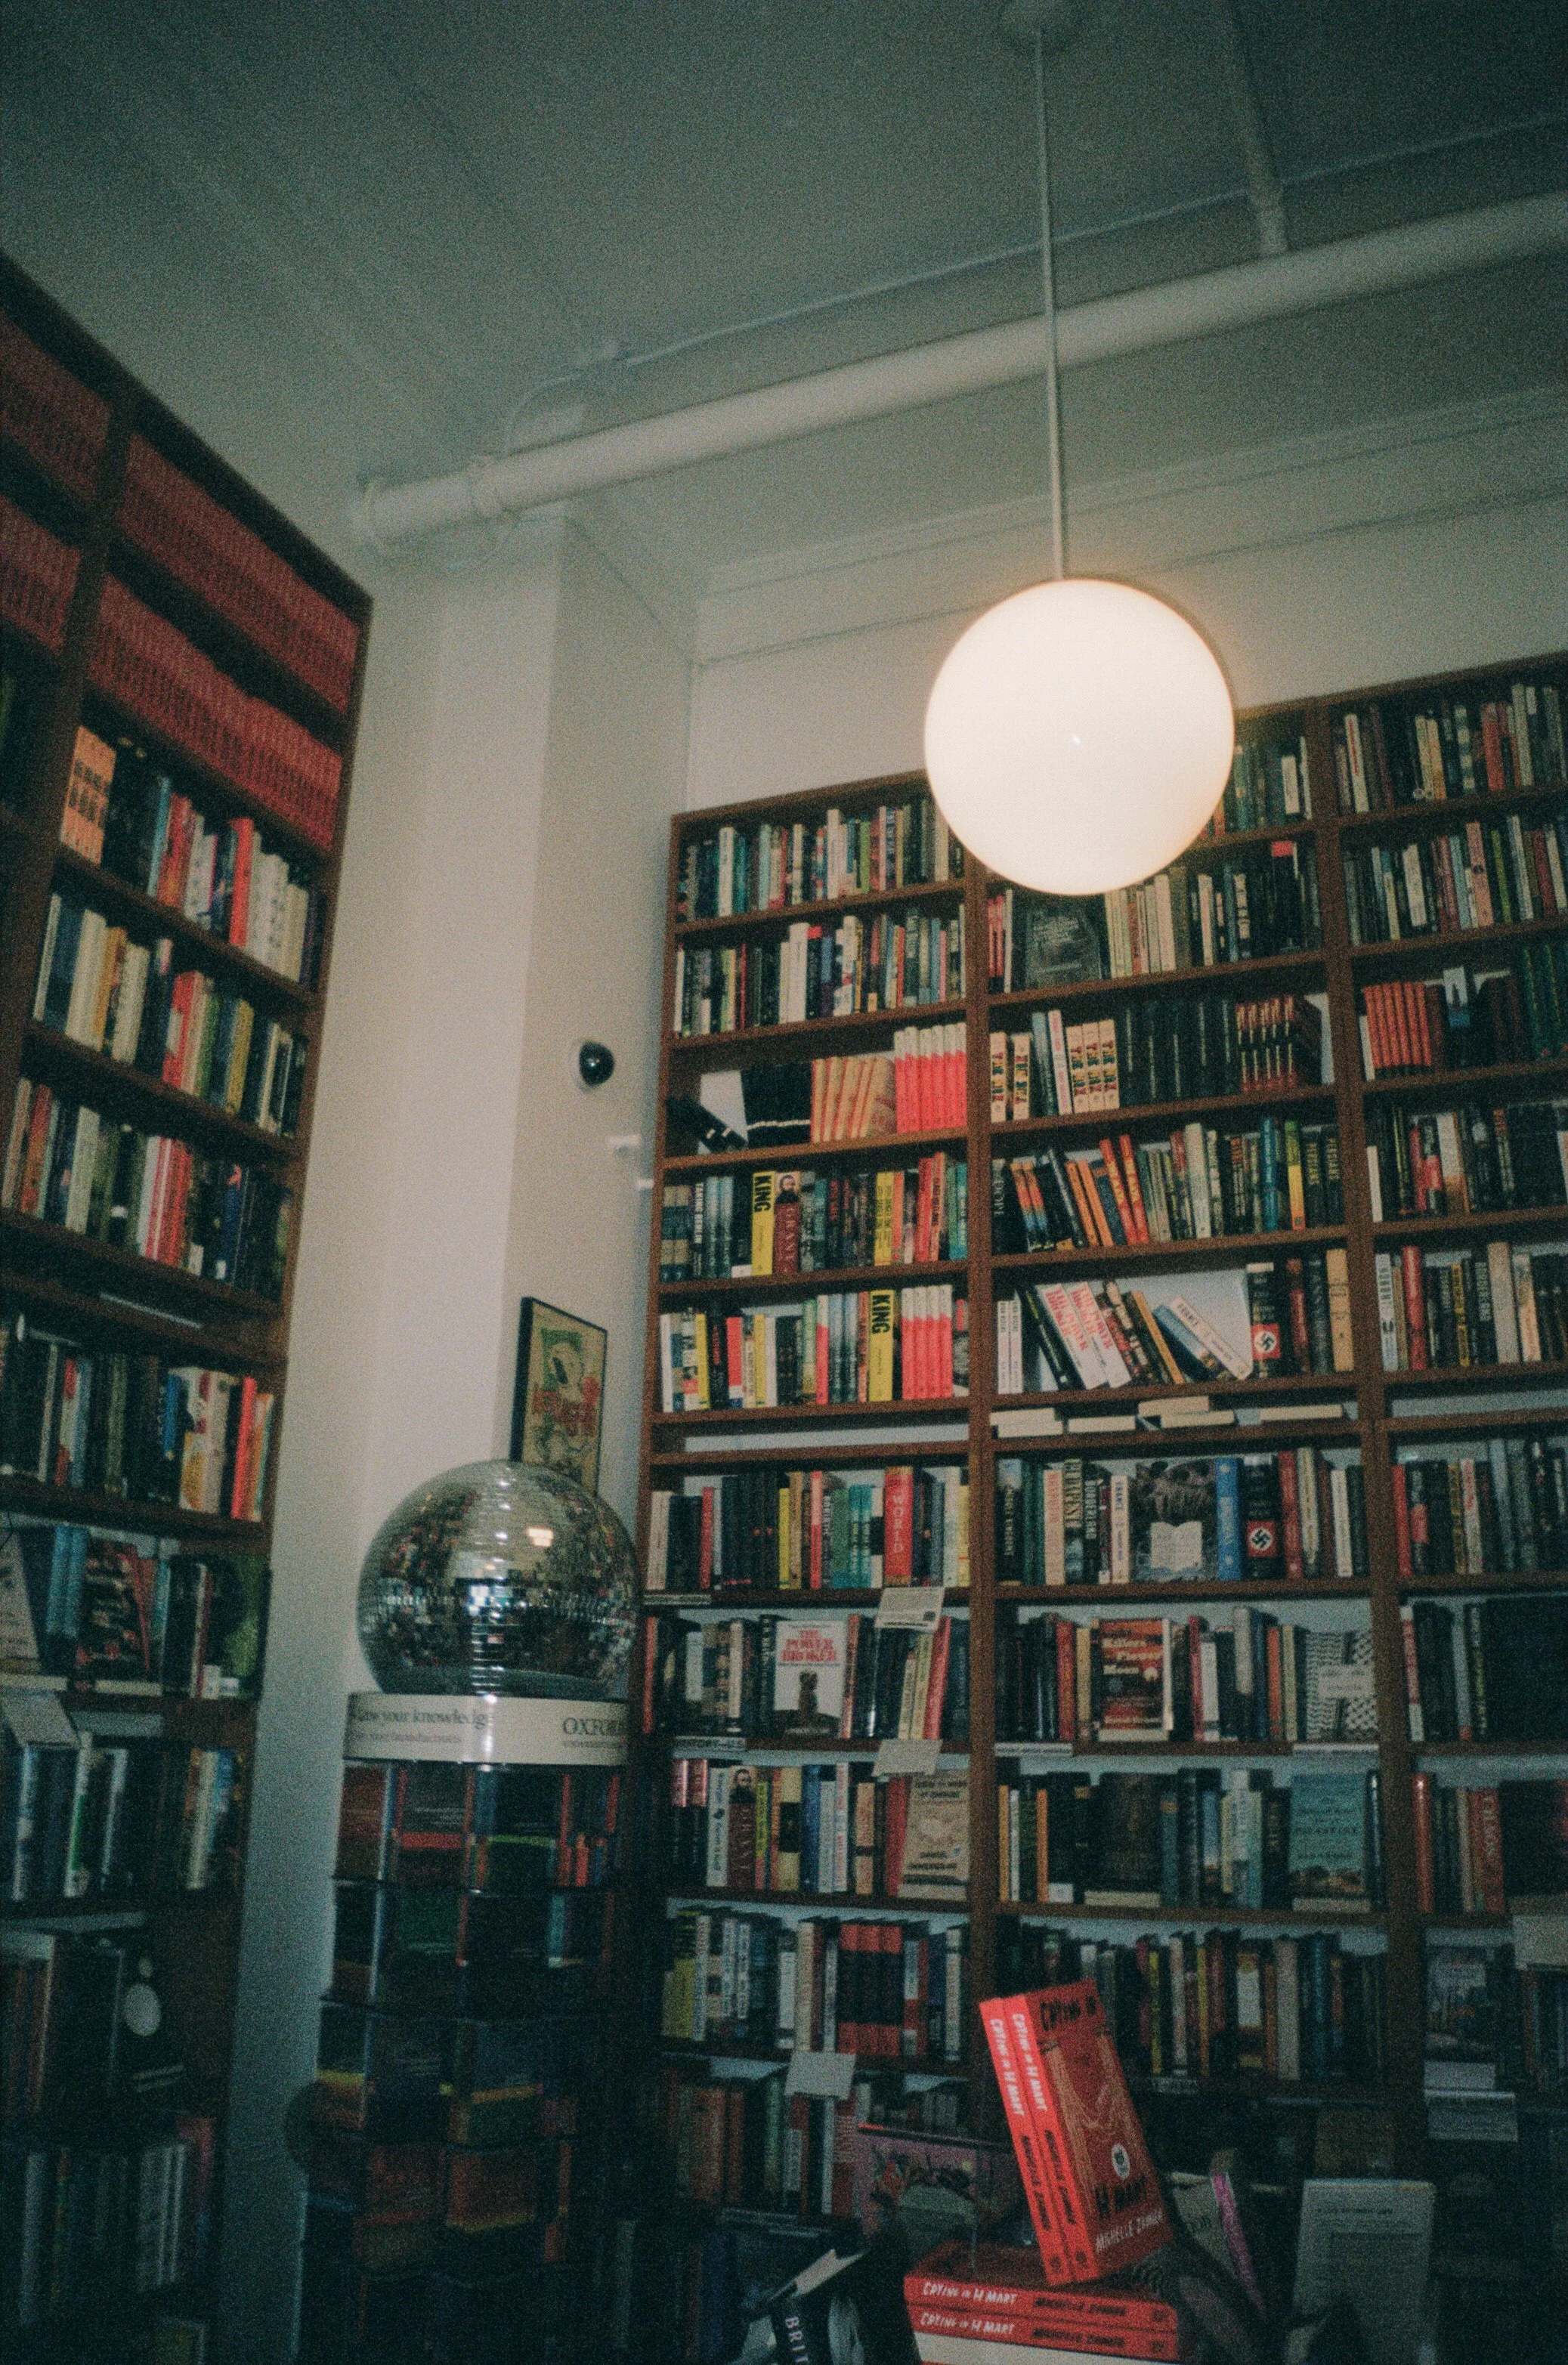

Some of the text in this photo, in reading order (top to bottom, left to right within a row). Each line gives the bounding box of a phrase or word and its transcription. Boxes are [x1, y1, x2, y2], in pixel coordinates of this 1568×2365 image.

[755, 1174, 772, 1213] KING
[786, 1208, 795, 1261] GRANT
[871, 1294, 892, 1334] KING
[892, 1495, 904, 1553] WORLD
[1103, 1638, 1146, 1647] Killers
[1003, 2070, 1015, 2082] H
[1025, 2064, 1037, 2076] H
[1006, 2082, 1024, 2116] MART
[1028, 2077, 1047, 2113] MART
[973, 2289, 983, 2300] H
[985, 2289, 1017, 2305] MART
[970, 2319, 982, 2331] H
[983, 2320, 1014, 2335] MART
